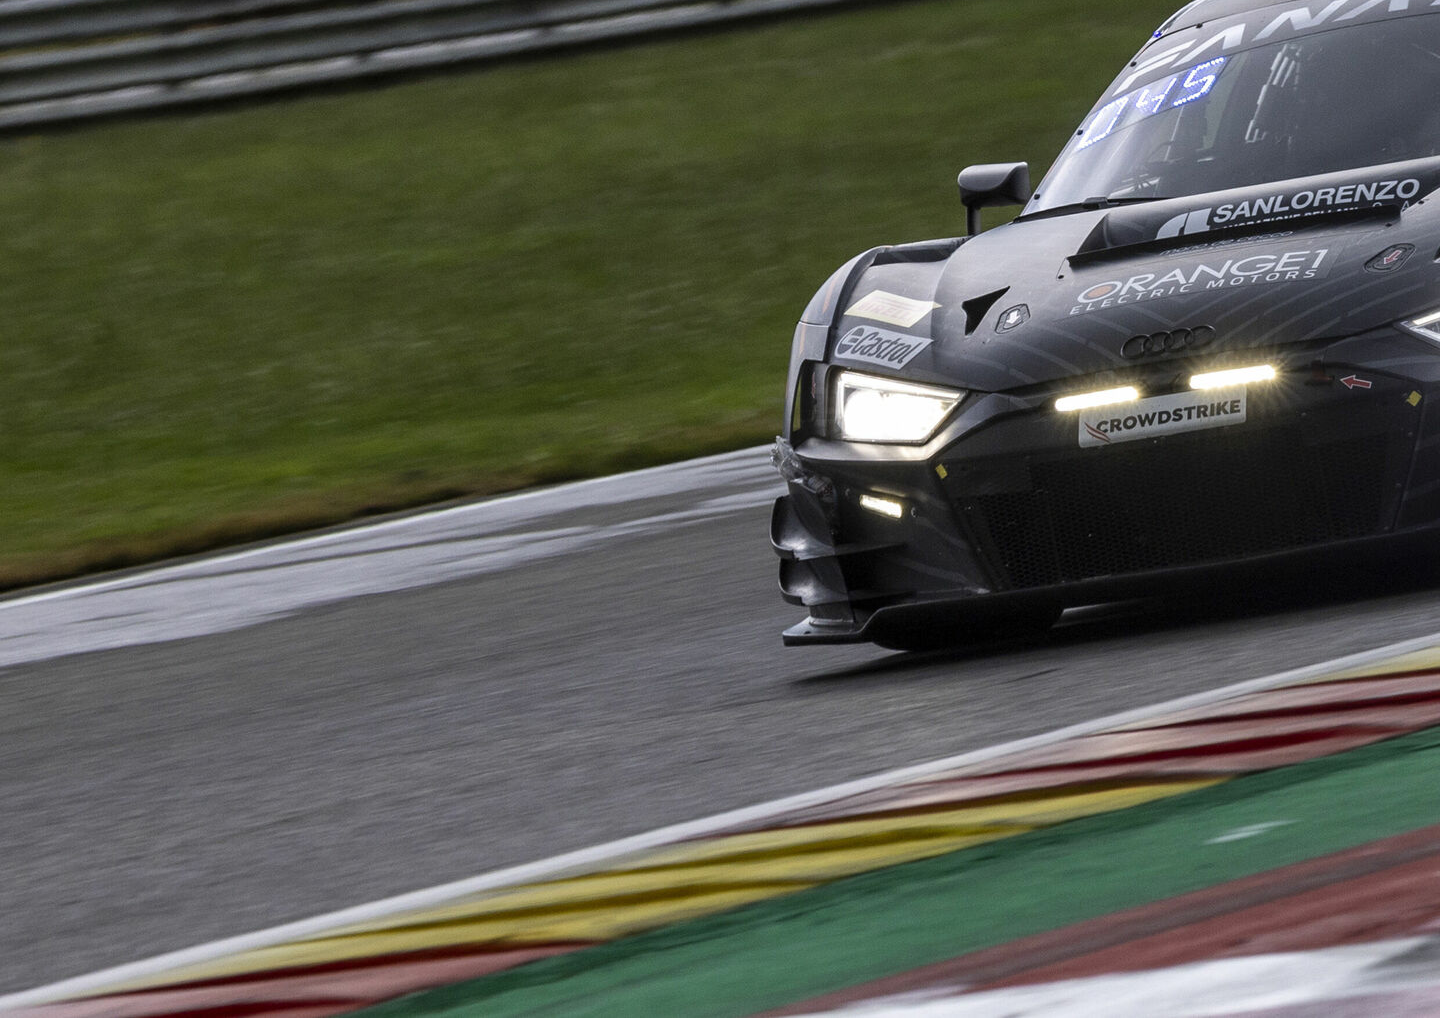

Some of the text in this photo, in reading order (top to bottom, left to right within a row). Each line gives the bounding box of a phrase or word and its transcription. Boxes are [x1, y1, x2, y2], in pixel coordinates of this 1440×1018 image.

[1213, 178, 1420, 223] SANLORENZO
[1069, 269, 1319, 315] ELECTRIC MOTORS
[1077, 248, 1329, 304] ORANGE1
[851, 332, 923, 364] Castrol
[1096, 399, 1241, 434] CROWDSTRIKE
